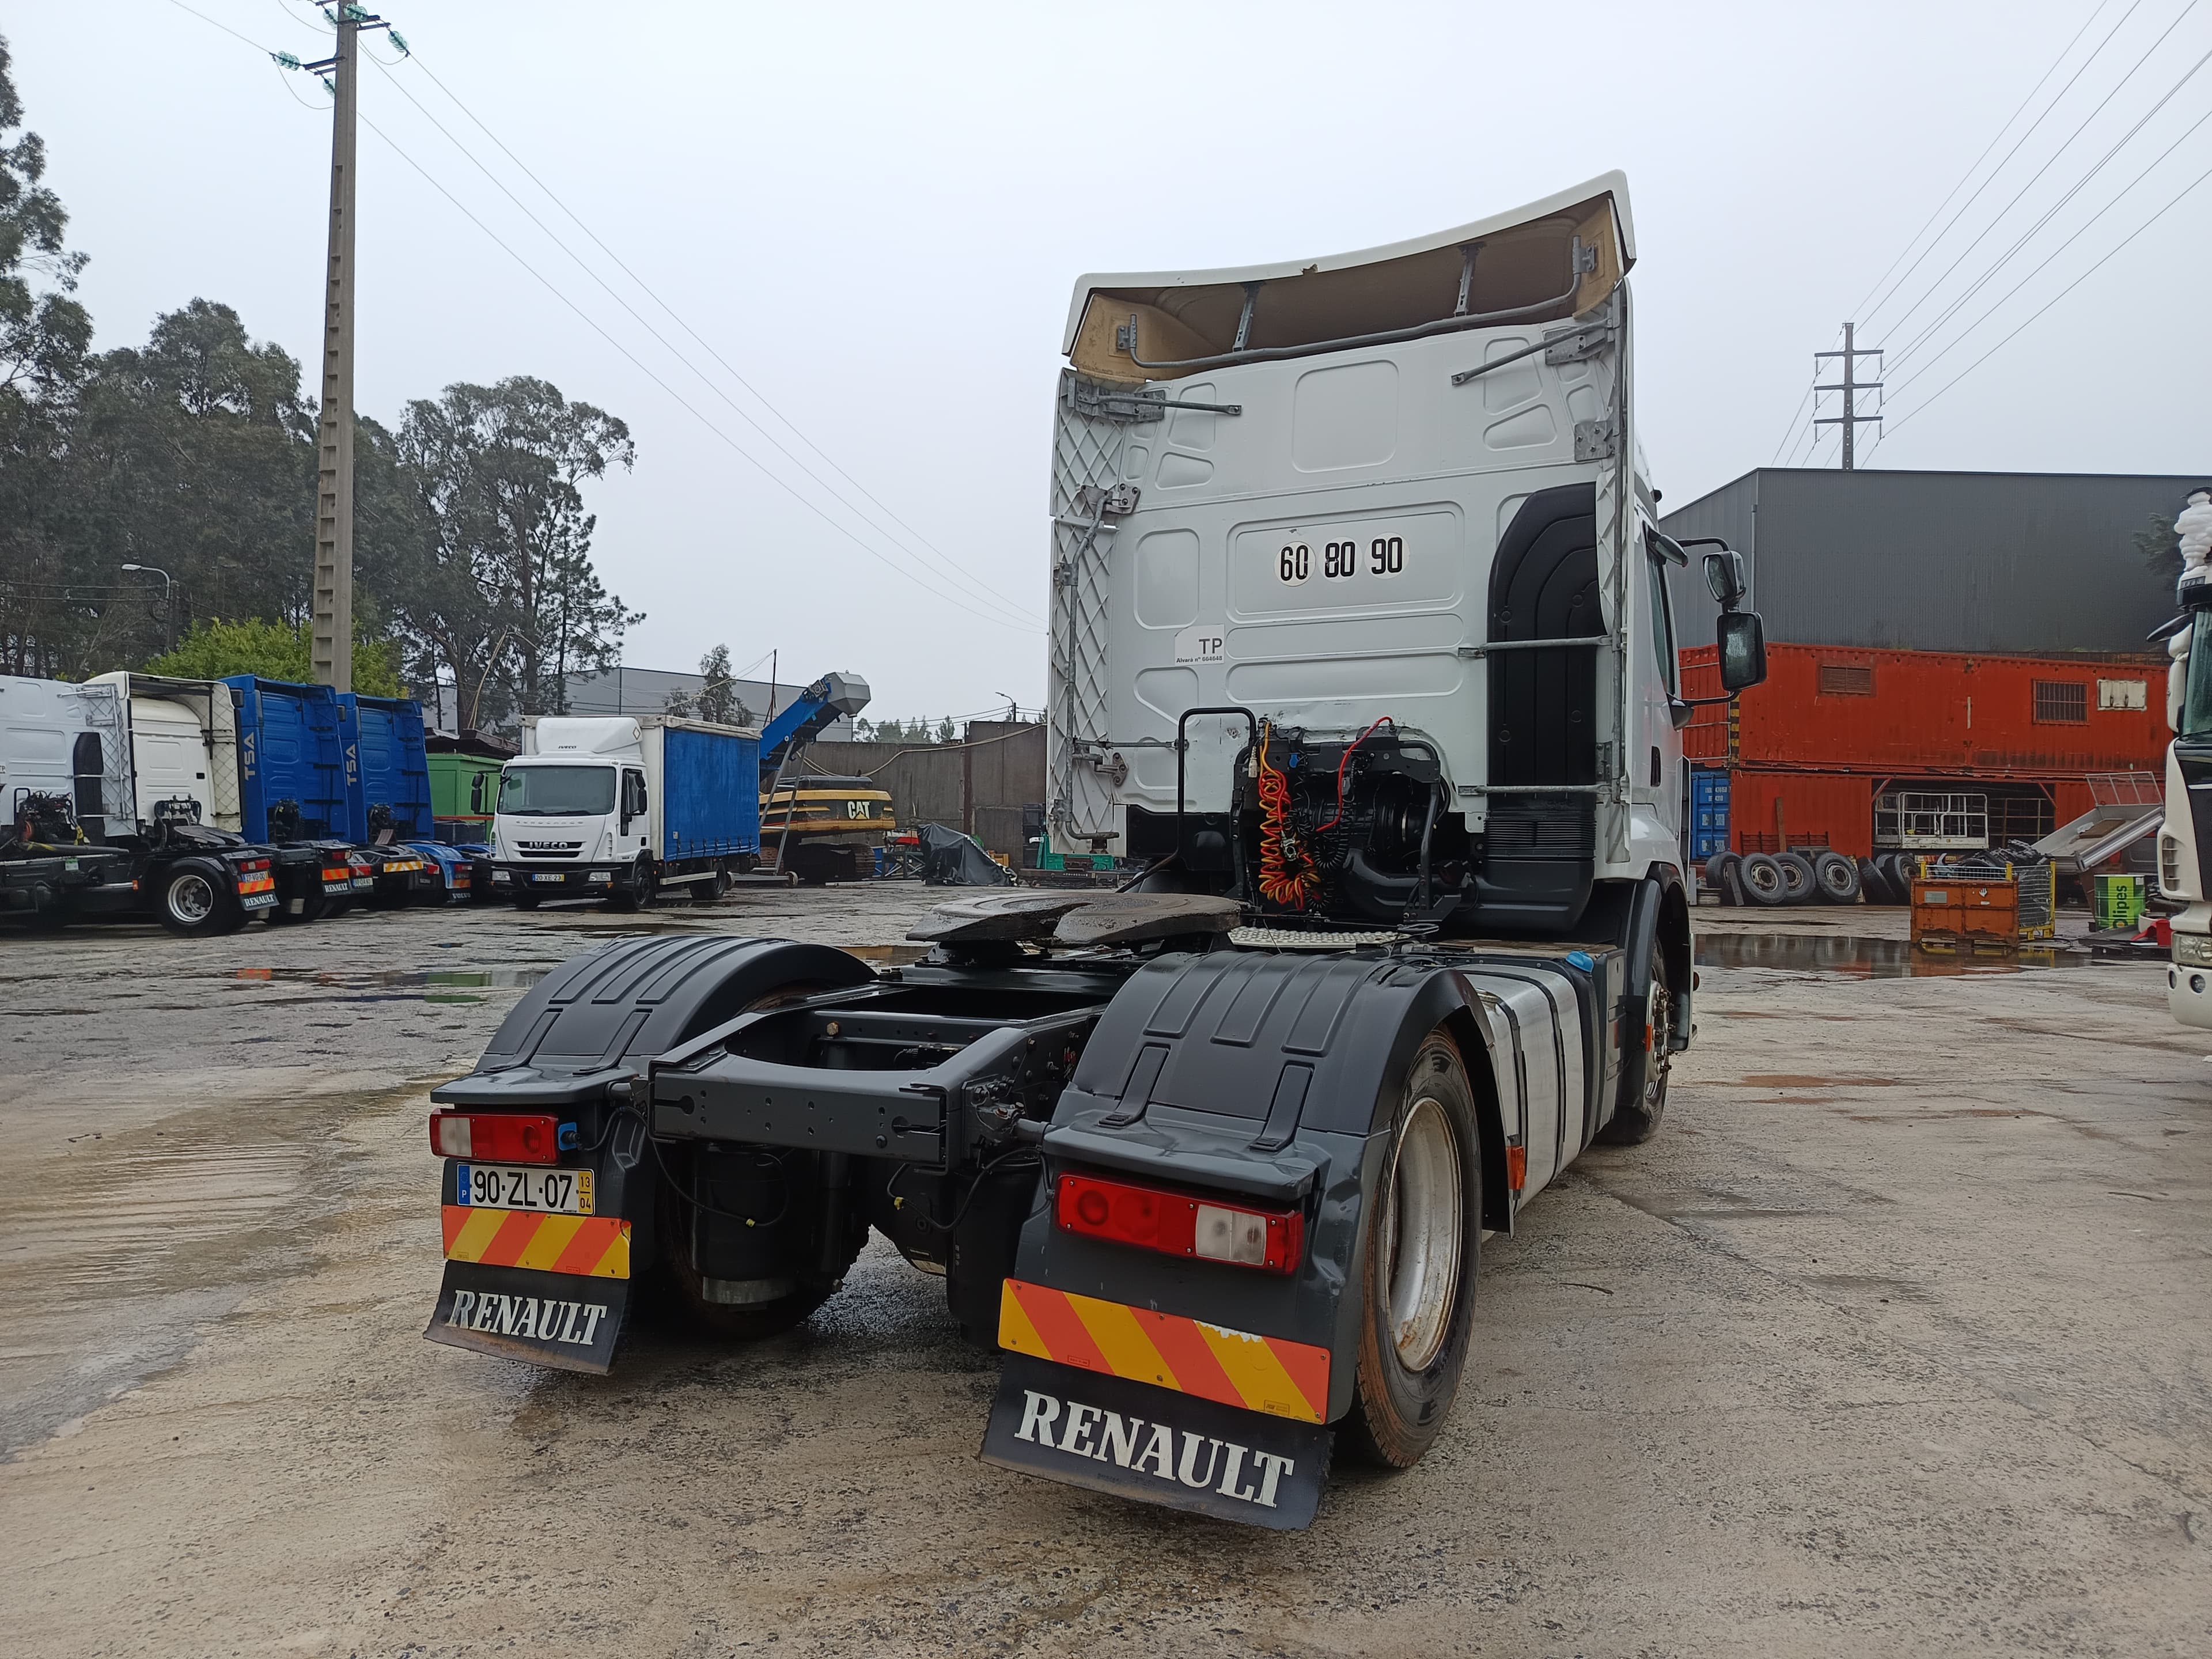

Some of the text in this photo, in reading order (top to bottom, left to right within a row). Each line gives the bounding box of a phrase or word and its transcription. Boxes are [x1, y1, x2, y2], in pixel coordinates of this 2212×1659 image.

[1281, 545, 1308, 581] 60
[1325, 541, 1355, 578] 80
[1372, 537, 1402, 574] 90
[1199, 638, 1222, 654] TP
[244, 732, 255, 781] TSA
[346, 743, 357, 787] TSA
[847, 801, 870, 820] CAT
[529, 842, 568, 850] IVECO
[324, 882, 348, 893] RENAULT
[244, 893, 275, 907] RENAULT
[581, 1176, 590, 1187] 13
[462, 1190, 467, 1198] P
[580, 1198, 590, 1209] 04
[446, 1289, 608, 1346] RENAULT
[1014, 1389, 1294, 1508] RENAULT
